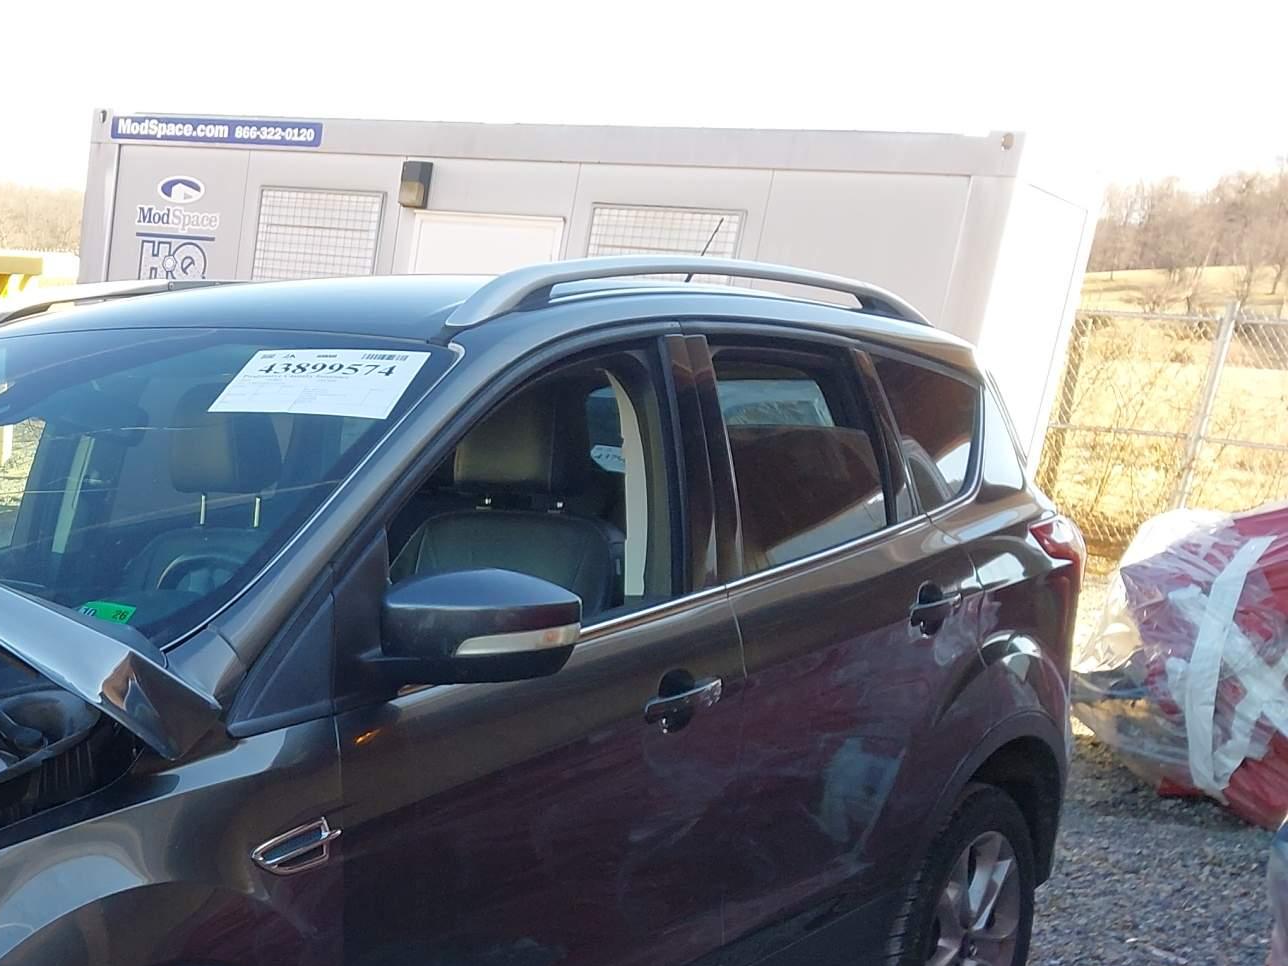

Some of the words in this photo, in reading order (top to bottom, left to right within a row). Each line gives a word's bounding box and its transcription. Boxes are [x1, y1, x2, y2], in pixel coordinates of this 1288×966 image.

[118, 118, 228, 138] ModSpace.com
[235, 125, 314, 141] 866-322-0120
[137, 206, 217, 231] ModSpace
[259, 362, 396, 376] 43899574
